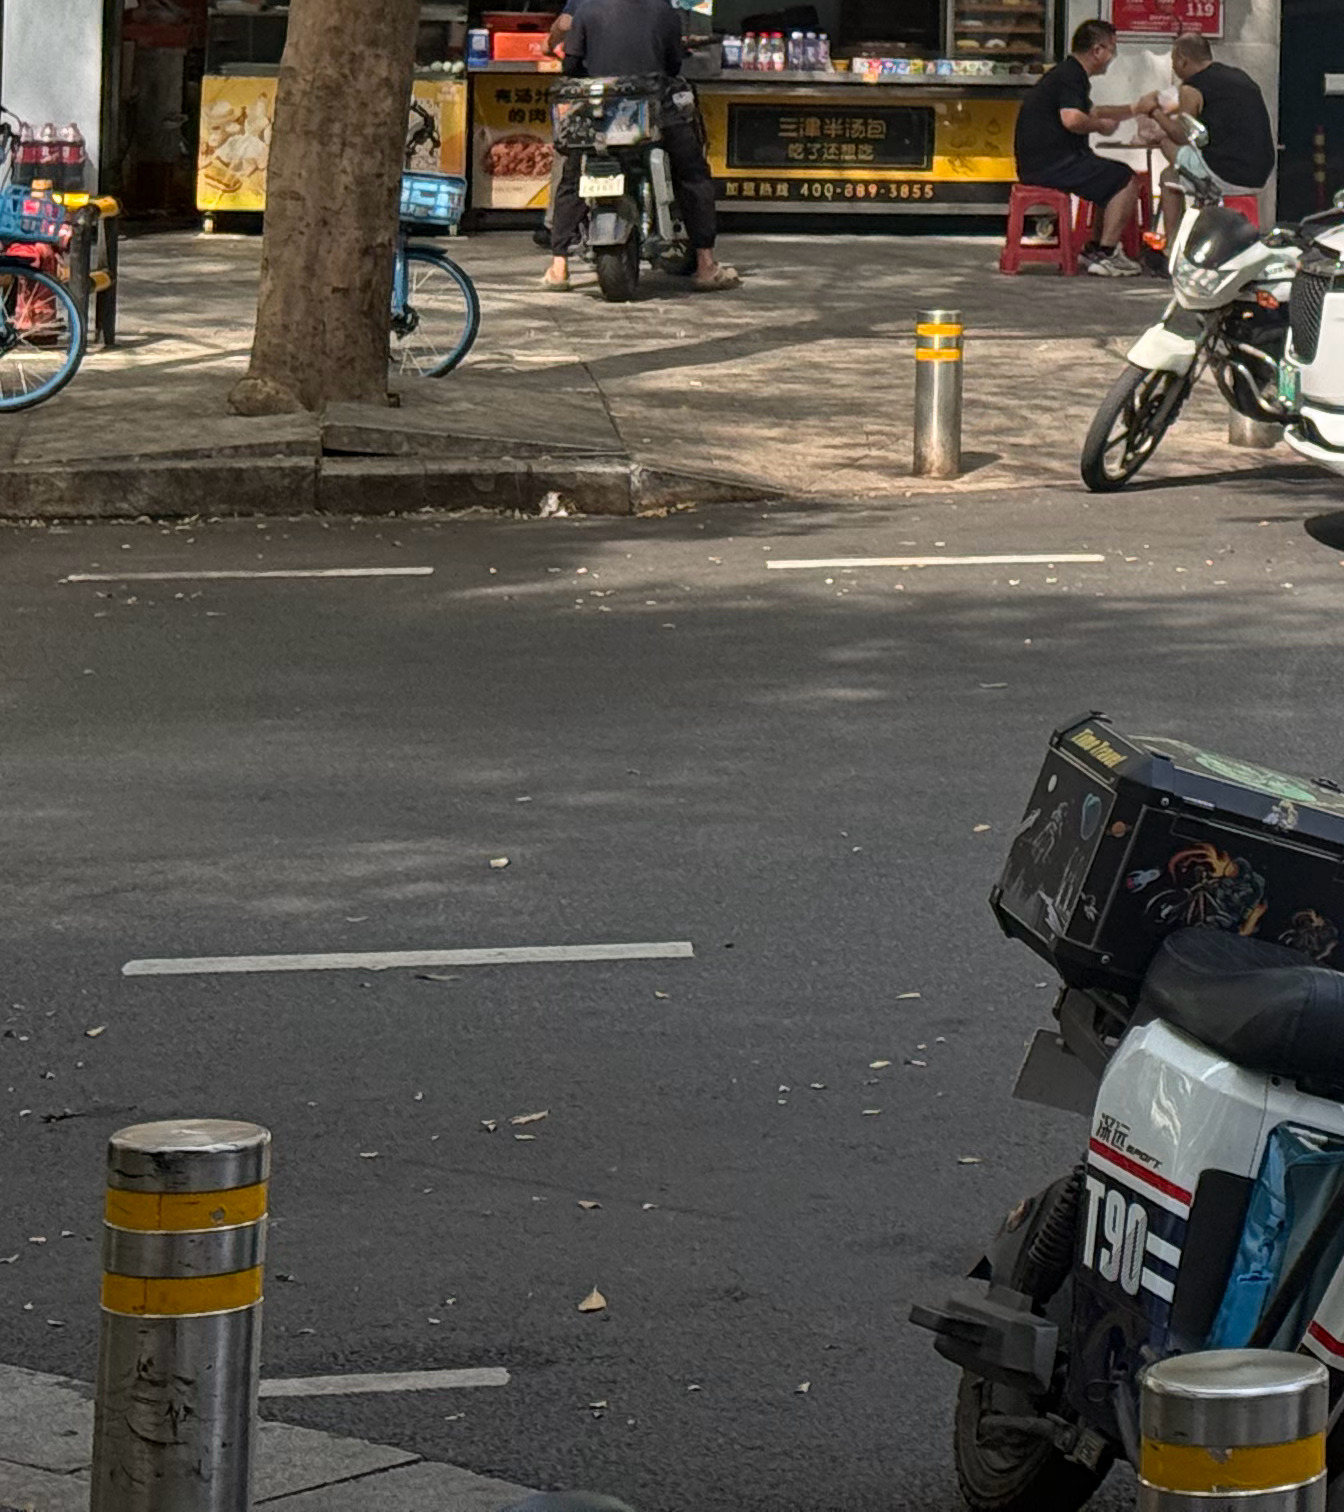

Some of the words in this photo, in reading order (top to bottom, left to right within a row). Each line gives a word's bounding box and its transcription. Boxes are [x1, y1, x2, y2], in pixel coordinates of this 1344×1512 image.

[1185, 2, 1215, 17] 119
[788, 143, 875, 161] 吃了还想吃
[1083, 1174, 1149, 1297] T90
